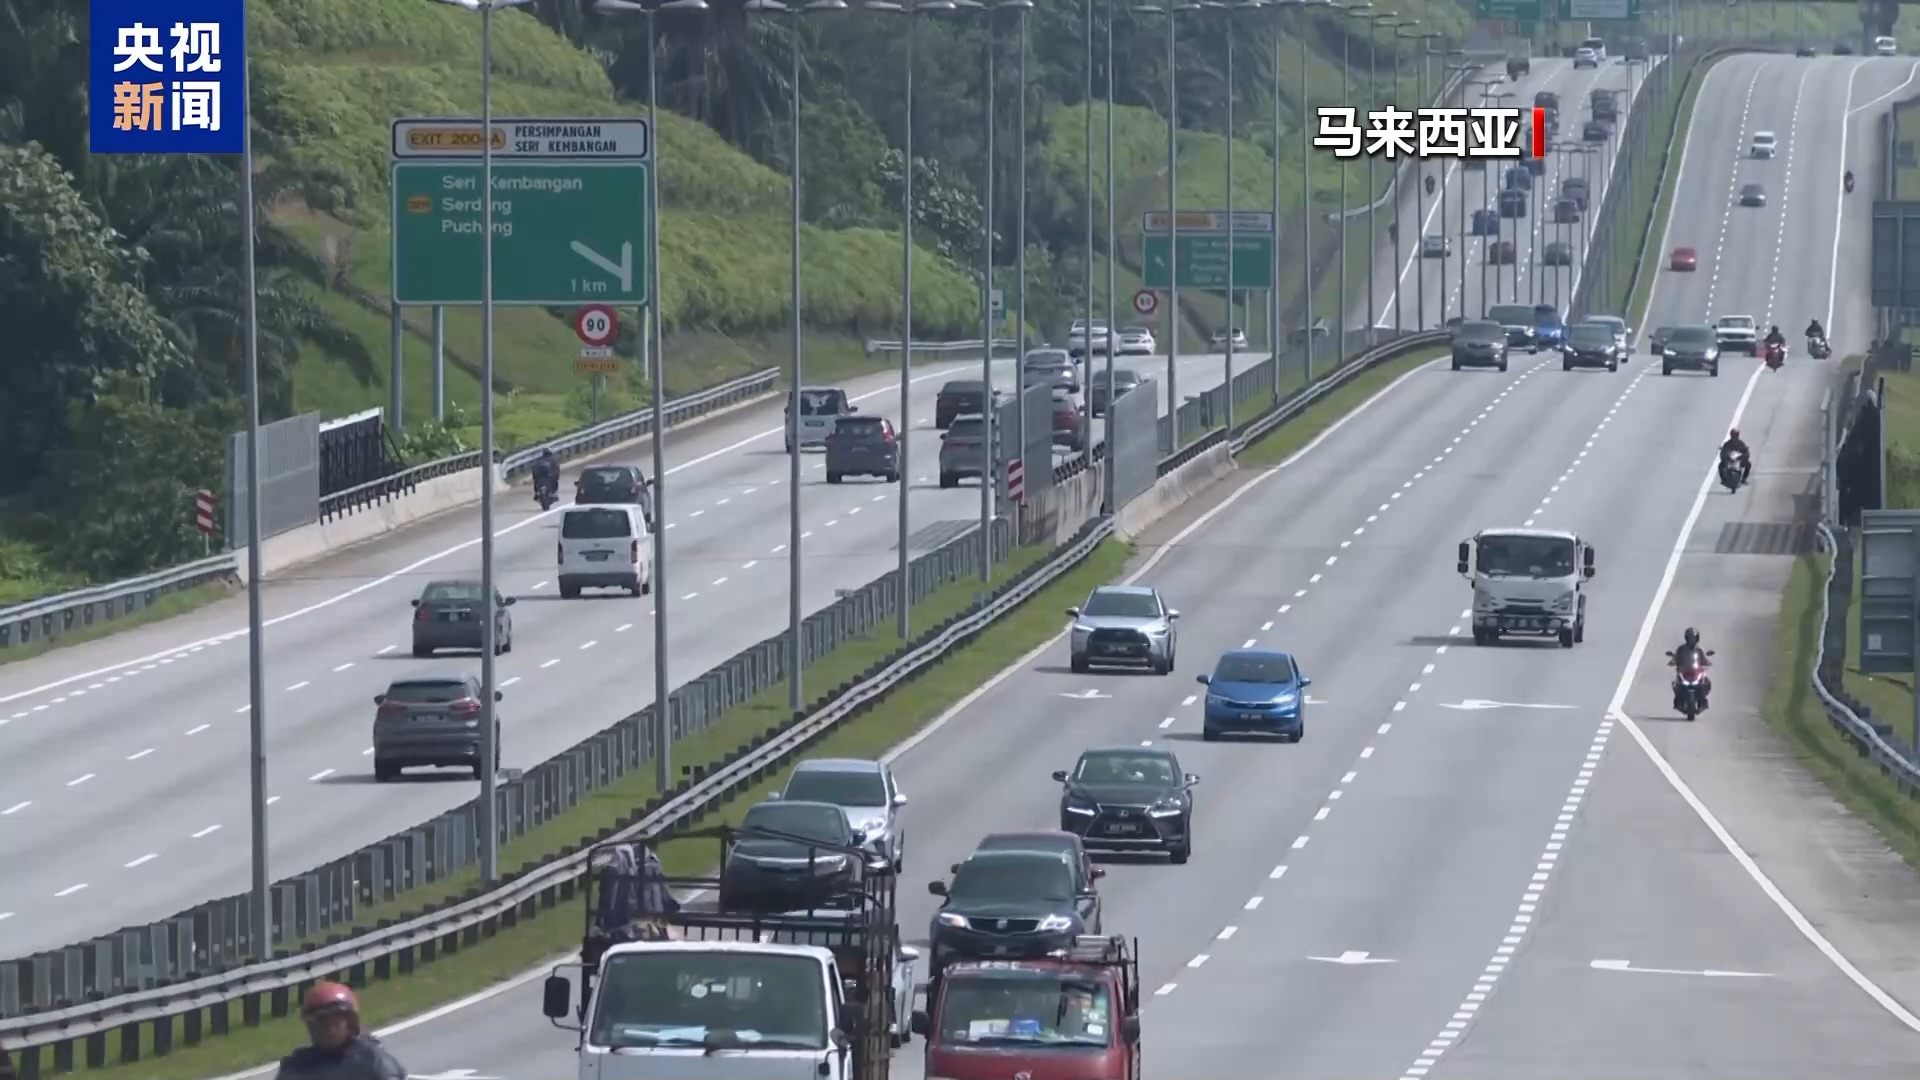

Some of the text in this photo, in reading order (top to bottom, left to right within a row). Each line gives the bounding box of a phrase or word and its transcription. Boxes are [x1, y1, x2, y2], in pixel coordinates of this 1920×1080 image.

[411, 132, 442, 144] EXIT
[515, 126, 601, 138] PERSIMPANGAN
[515, 141, 617, 153] SERI KEMBANGAN
[442, 175, 475, 190] Seri
[442, 196, 512, 216] Serdng
[442, 219, 513, 237] Puchng
[570, 278, 607, 293] 1 km
[586, 318, 605, 332] 90
